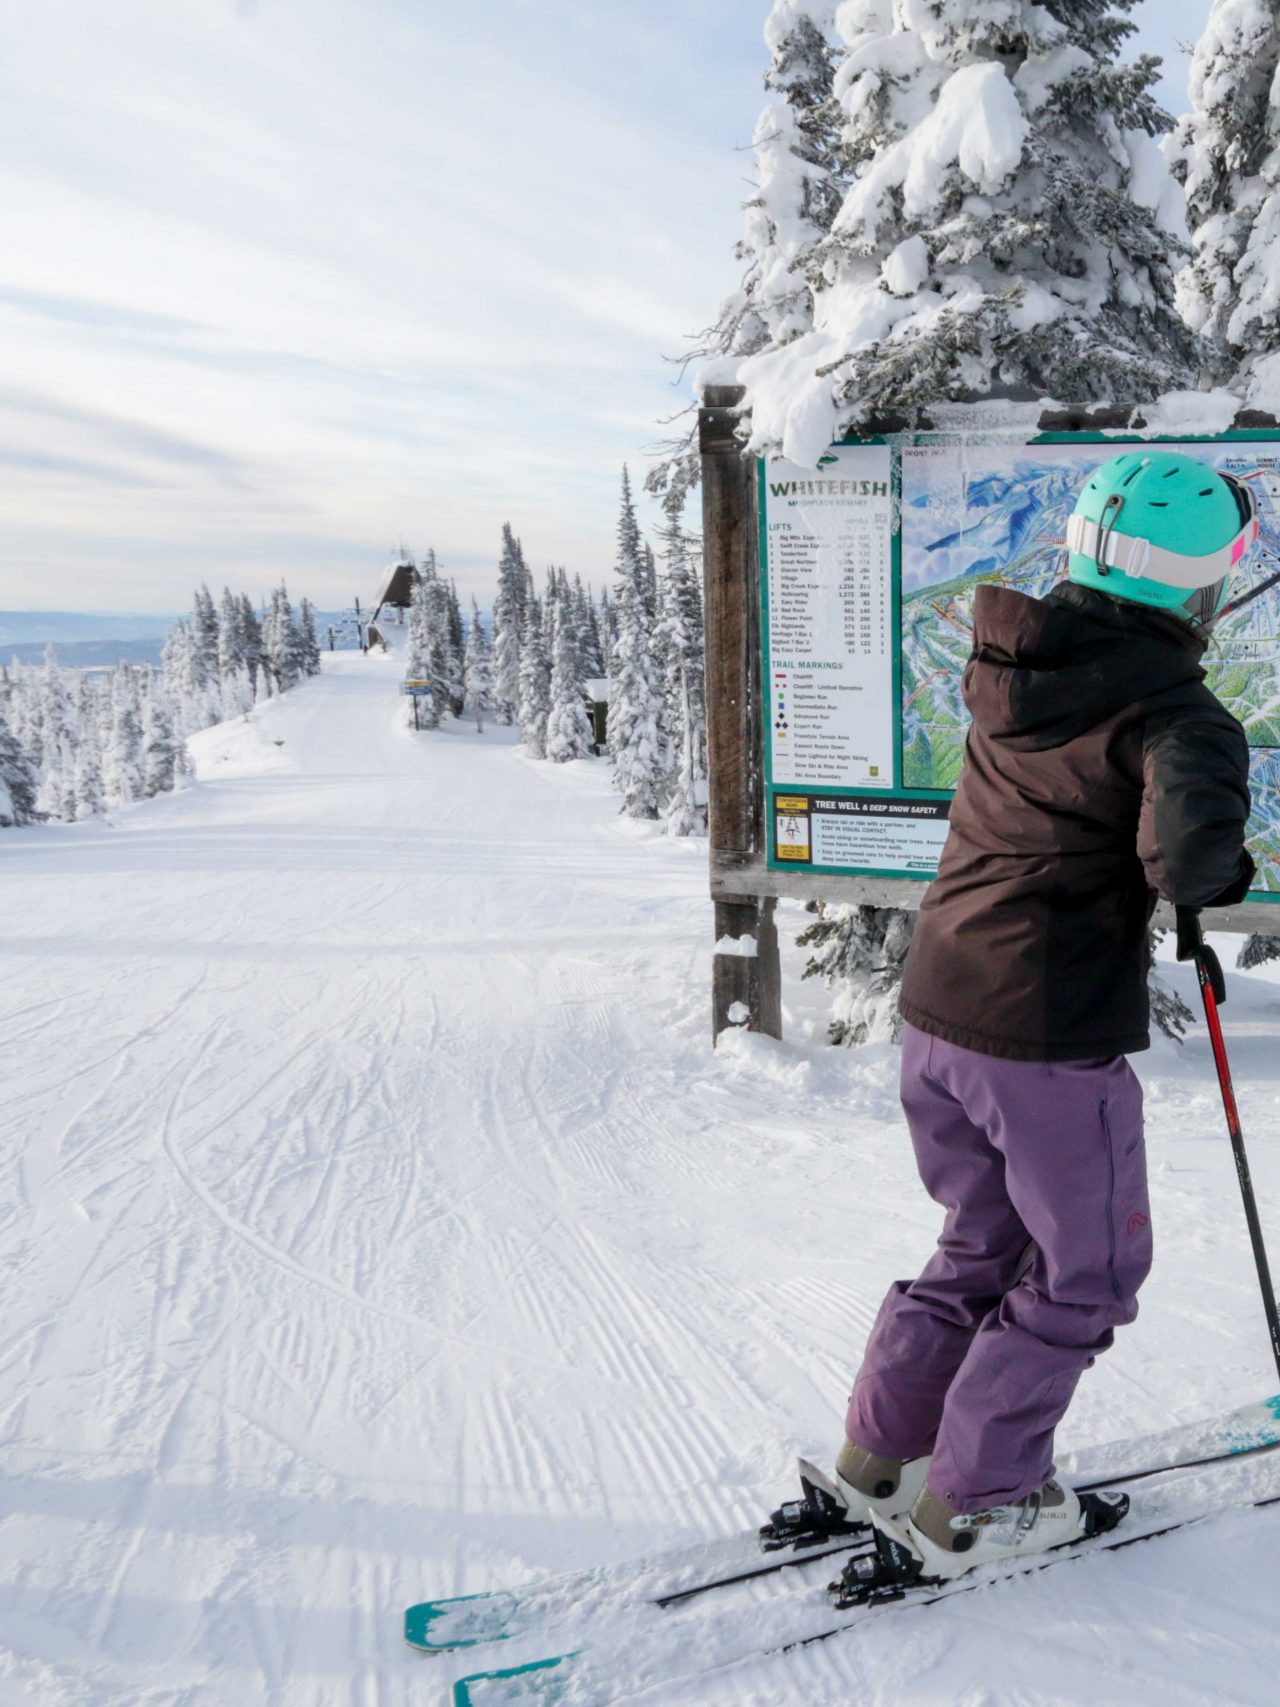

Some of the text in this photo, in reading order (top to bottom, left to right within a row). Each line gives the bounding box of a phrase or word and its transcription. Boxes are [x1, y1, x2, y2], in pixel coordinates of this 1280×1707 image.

[769, 481, 887, 496] WHITEFISH
[815, 800, 836, 808] TREE
[838, 801, 860, 810] WELL
